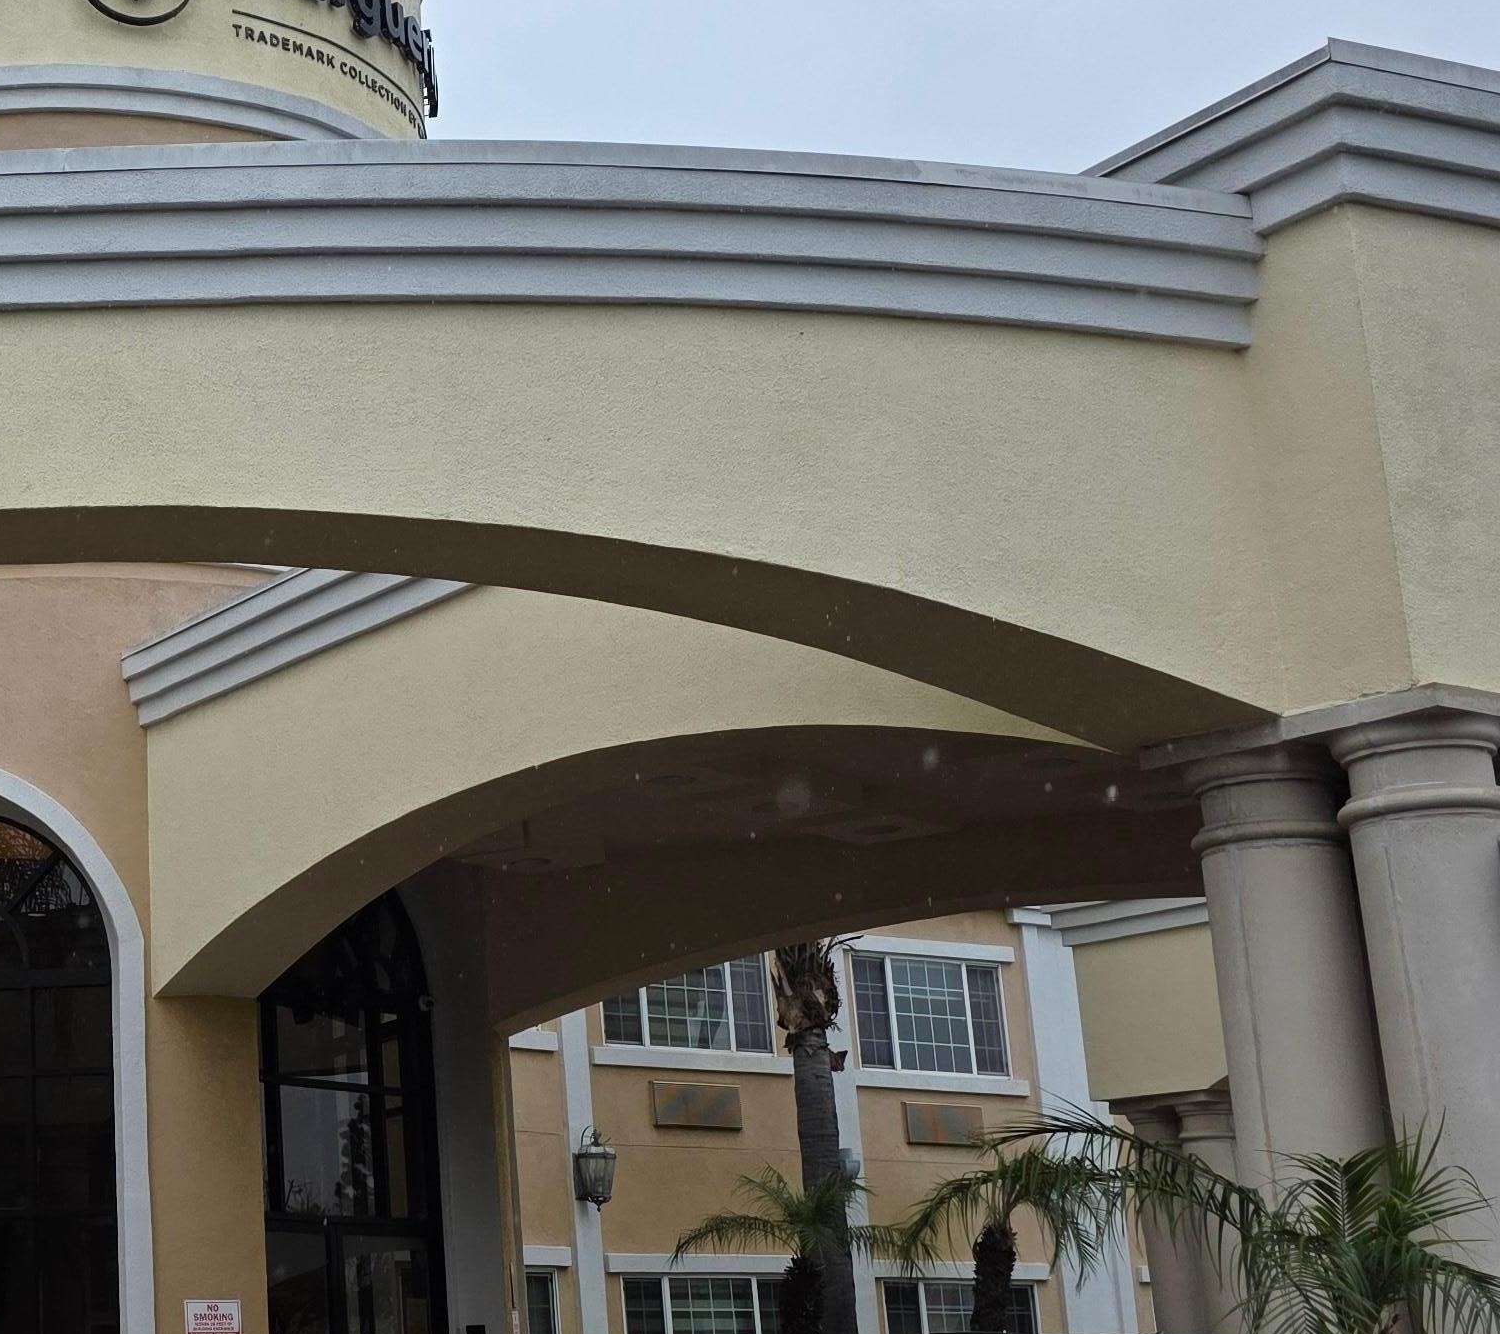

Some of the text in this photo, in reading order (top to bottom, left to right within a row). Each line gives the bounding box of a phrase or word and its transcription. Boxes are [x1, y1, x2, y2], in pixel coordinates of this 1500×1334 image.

[232, 24, 336, 70] TRADEMARK
[339, 61, 408, 117] COLLECTION
[207, 1304, 219, 1312] NO
[193, 1313, 234, 1322] SMOKING
